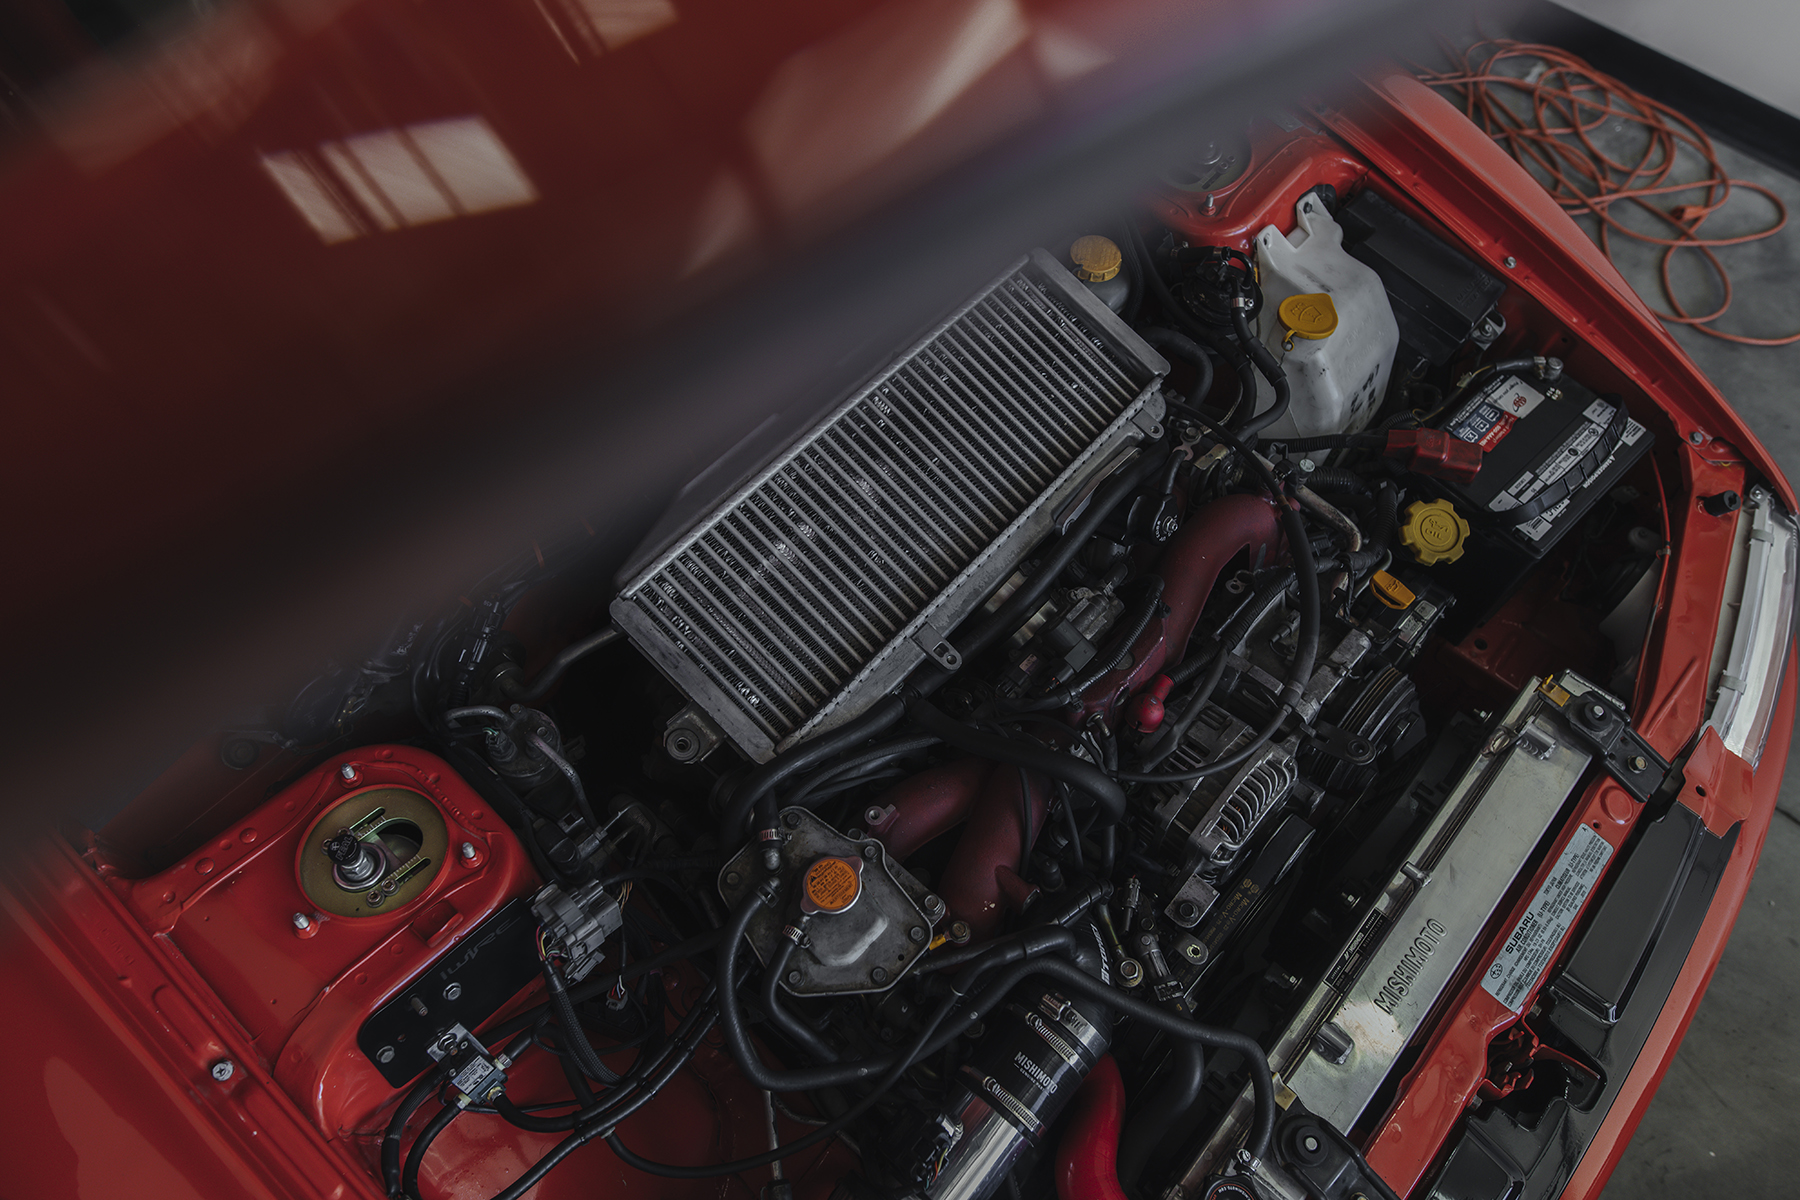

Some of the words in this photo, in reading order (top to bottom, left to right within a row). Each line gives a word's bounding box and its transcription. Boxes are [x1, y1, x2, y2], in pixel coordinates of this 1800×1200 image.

[1424, 528, 1442, 540] OIL
[334, 836, 353, 861] FEAL
[1504, 911, 1535, 954] SUBARU
[1519, 919, 1539, 945] CONDITIONER
[1373, 917, 1449, 1016] MISHIMOTO
[1013, 1050, 1058, 1094] MISHIMOTO
